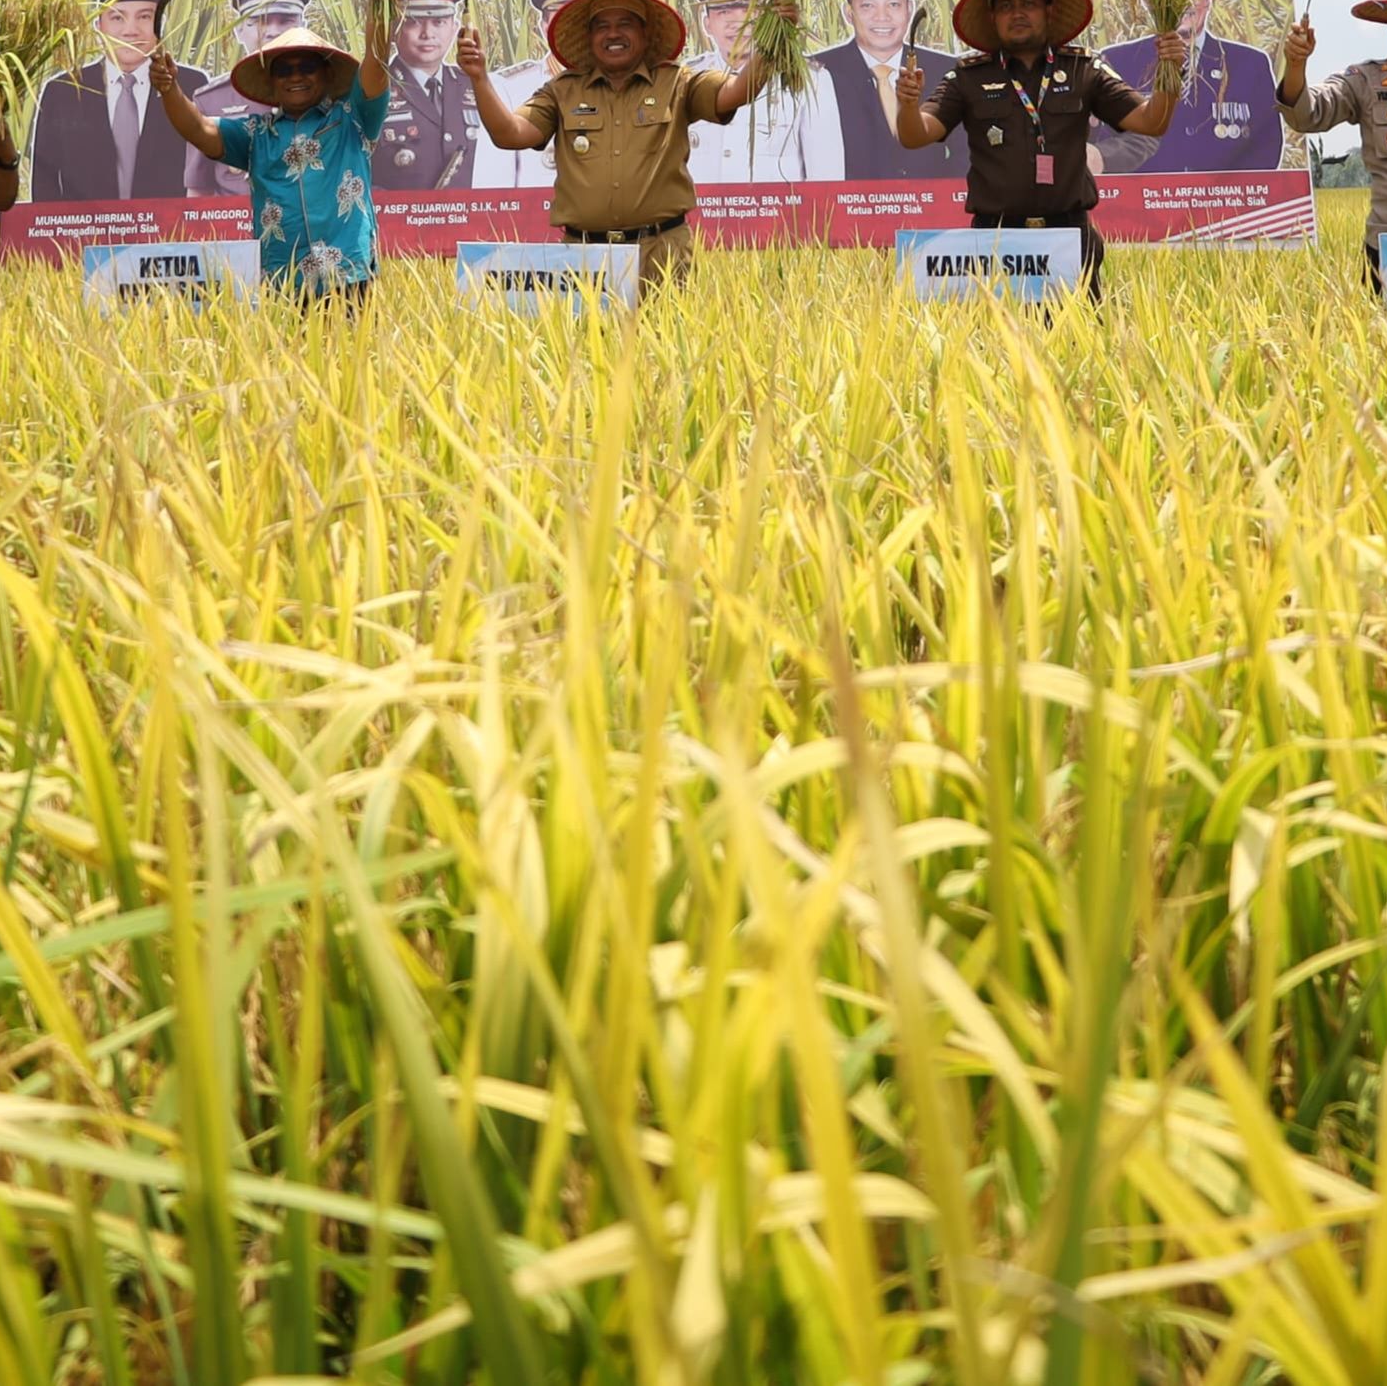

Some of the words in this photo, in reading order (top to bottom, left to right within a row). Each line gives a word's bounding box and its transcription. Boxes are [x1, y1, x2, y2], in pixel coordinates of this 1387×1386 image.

[837, 193, 866, 204] INDRA
[868, 193, 919, 204] GUNAWAN,
[921, 192, 934, 203] SE
[1142, 188, 1162, 199] Drs.
[1163, 187, 1173, 198] H.
[1174, 186, 1206, 198] ARFAN
[1207, 185, 1244, 197] USMAN,
[1246, 185, 1269, 196] M.Pd
[384, 204, 408, 214] ASEP
[411, 202, 469, 214] SUJARWADI,
[500, 200, 520, 211] M.Si
[724, 195, 760, 208] MERZA,
[761, 195, 784, 207] BBA,
[785, 194, 802, 205] MM
[1144, 198, 1189, 210] Sekretaris
[1191, 197, 1223, 209] Daerah
[1225, 197, 1245, 207] Kab.
[1247, 196, 1267, 207] Siak
[183, 210, 199, 222] TRI
[201, 209, 249, 221] ANGGORO
[702, 207, 727, 218] Wakil
[728, 207, 757, 220] Bupati
[759, 206, 779, 217] Siak
[847, 205, 873, 215] Ketua
[874, 204, 901, 215] DPRD
[903, 204, 923, 214] Siak
[35, 214, 92, 226] MUHAMMAD
[94, 213, 136, 225] HIBRIAN,
[137, 212, 154, 222] S.H
[406, 214, 446, 227] Kapolres
[448, 214, 468, 225] Siak
[28, 227, 55, 238] Ketua
[56, 225, 107, 239] Pengadilan
[108, 224, 138, 237] Negeri
[140, 224, 160, 234] Siak
[139, 255, 200, 278] KETUA
[1001, 254, 1051, 276] SIAK
